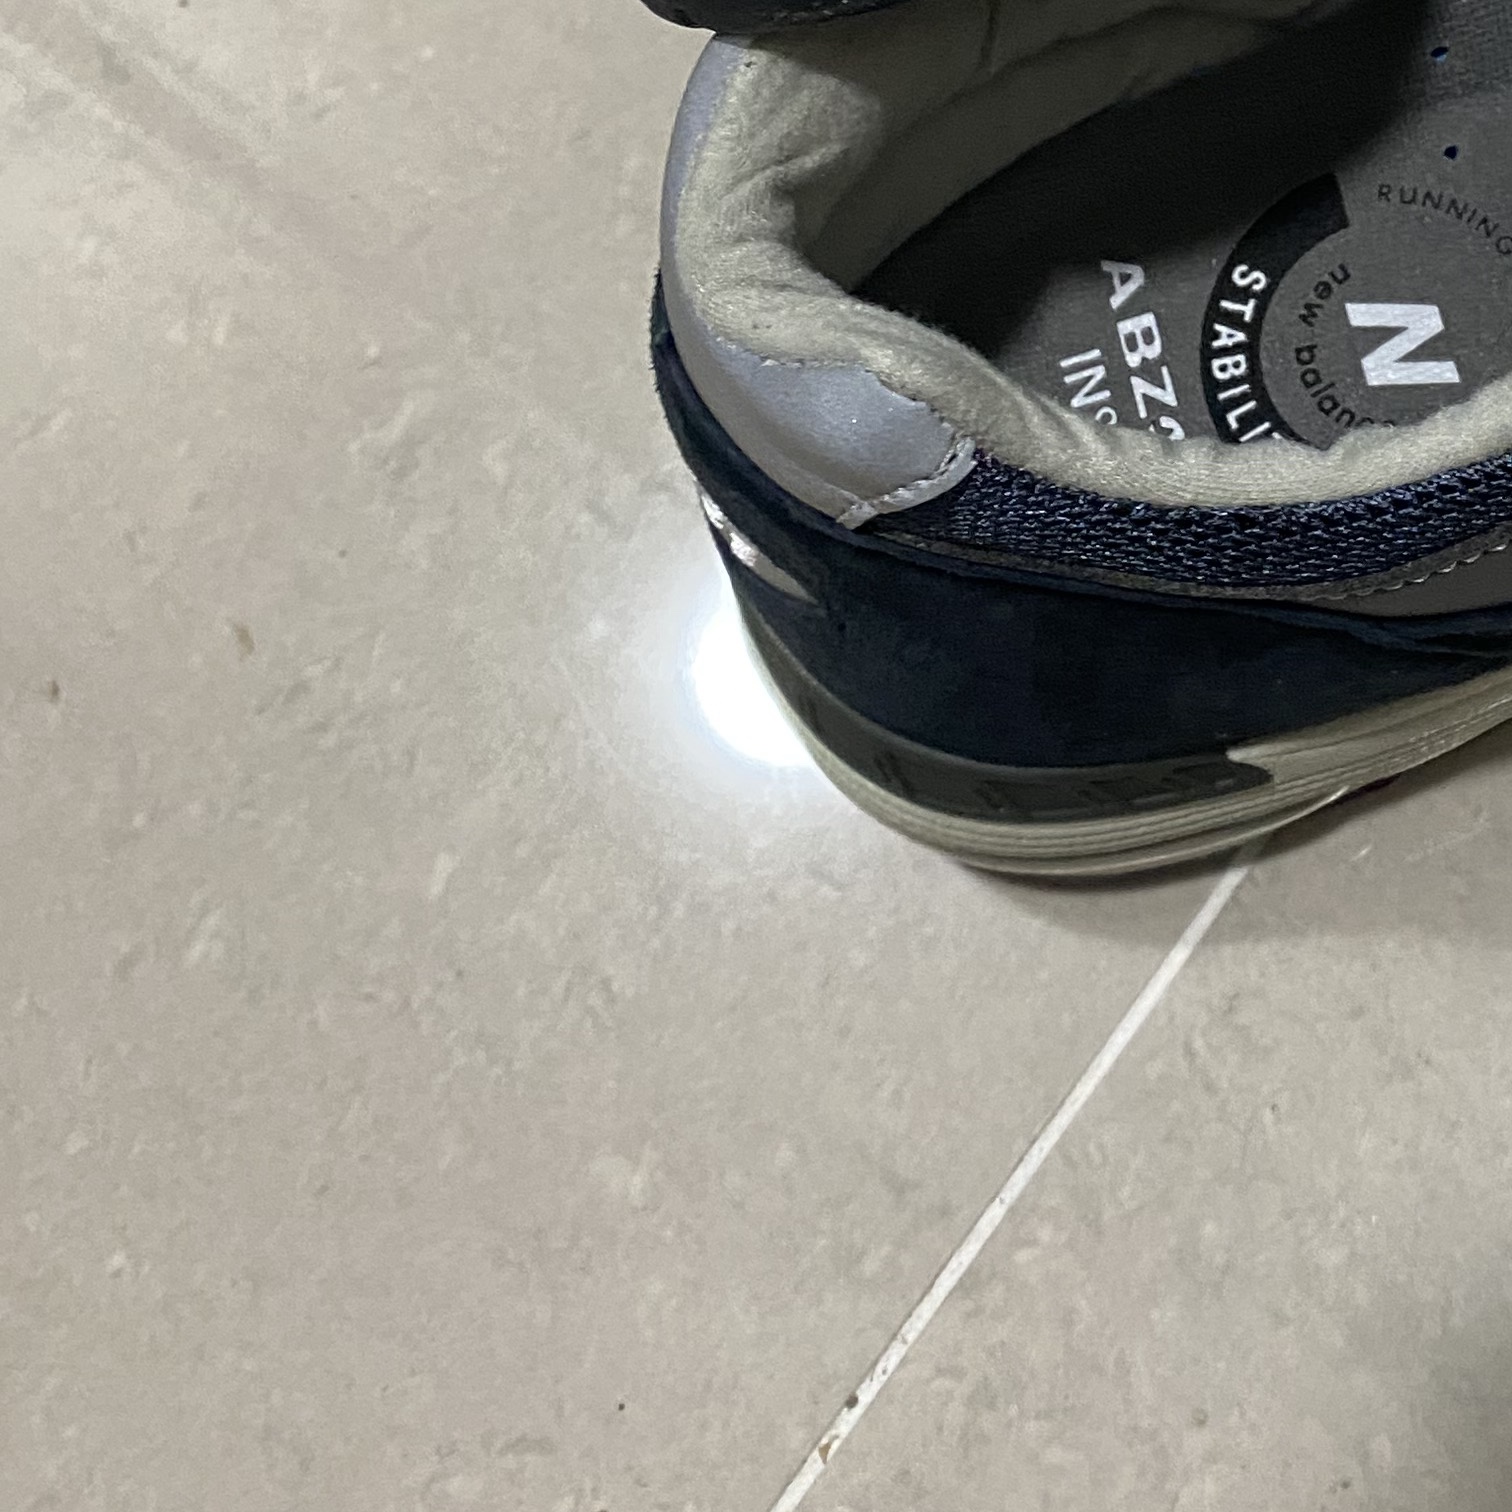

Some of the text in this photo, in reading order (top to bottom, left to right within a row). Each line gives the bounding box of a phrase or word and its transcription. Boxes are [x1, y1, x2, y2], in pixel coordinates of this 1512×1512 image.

[1299, 263, 1351, 327] new
[1210, 263, 1282, 443] STABILI
[1344, 302, 1461, 387] N
